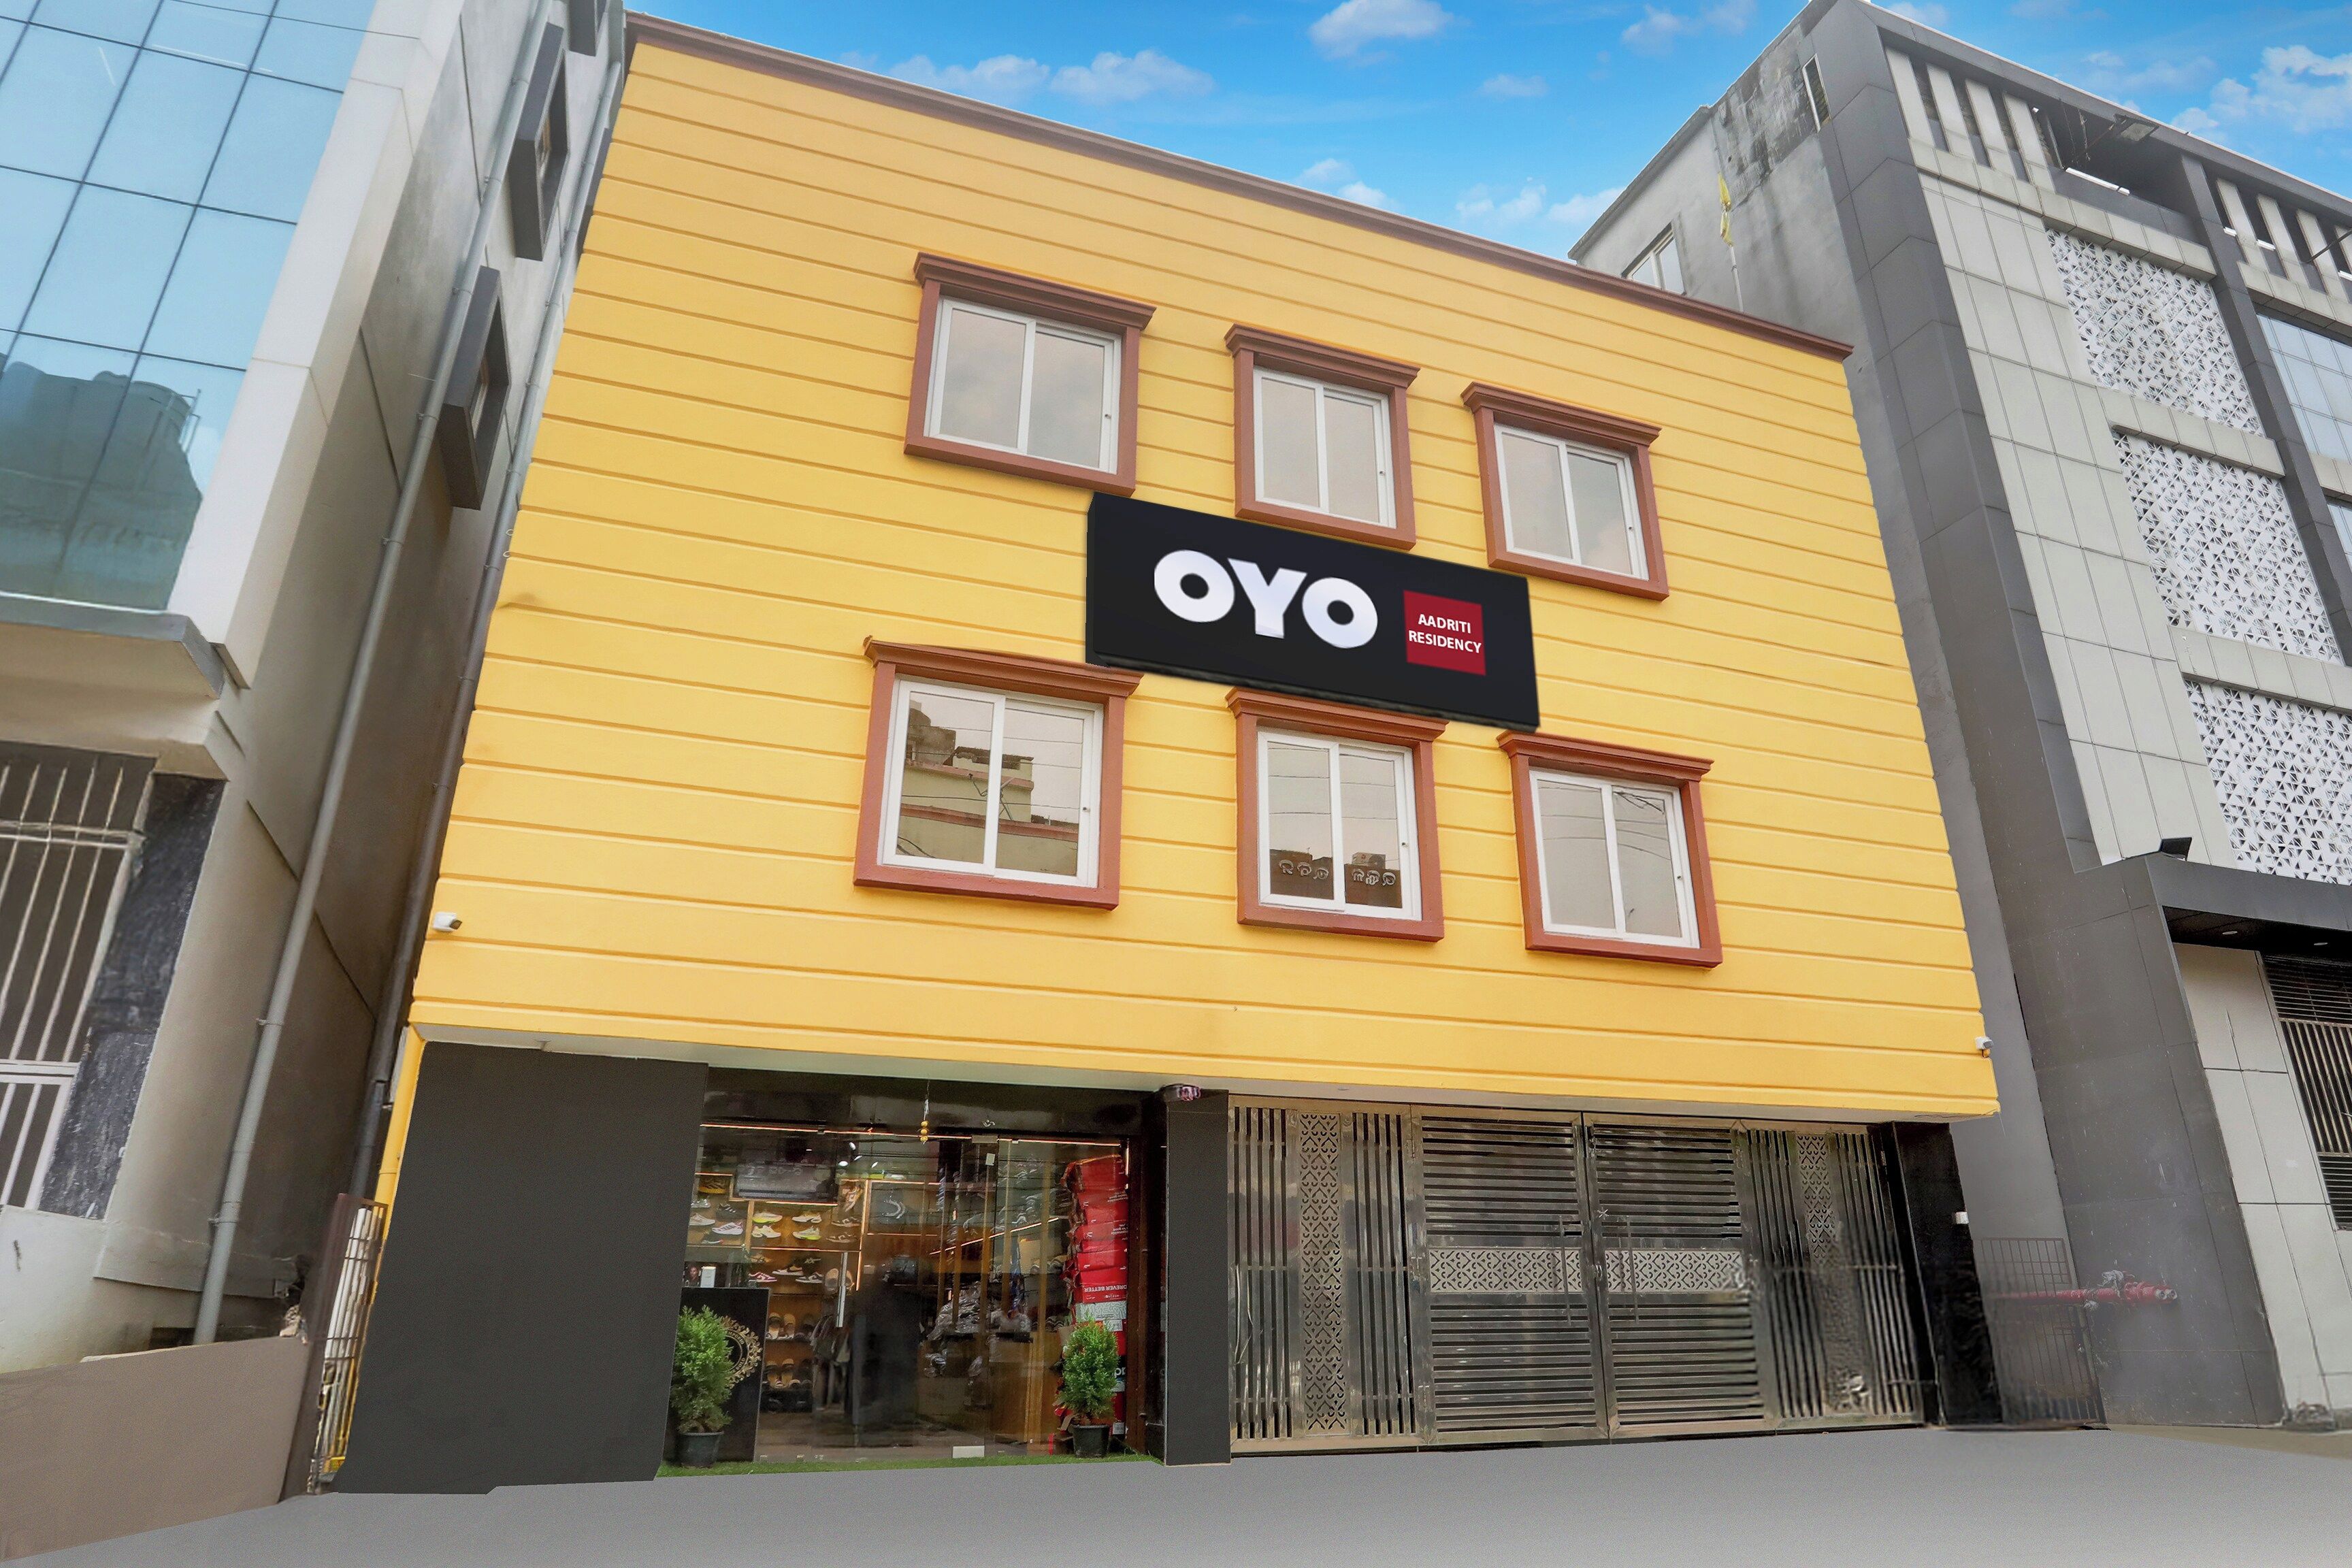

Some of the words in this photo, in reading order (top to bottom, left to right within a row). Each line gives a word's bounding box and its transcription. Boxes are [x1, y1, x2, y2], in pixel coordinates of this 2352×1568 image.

[1154, 550, 1378, 649] OYO
[1418, 613, 1471, 634] AADRITI
[1408, 630, 1482, 653] RESIDENCY
